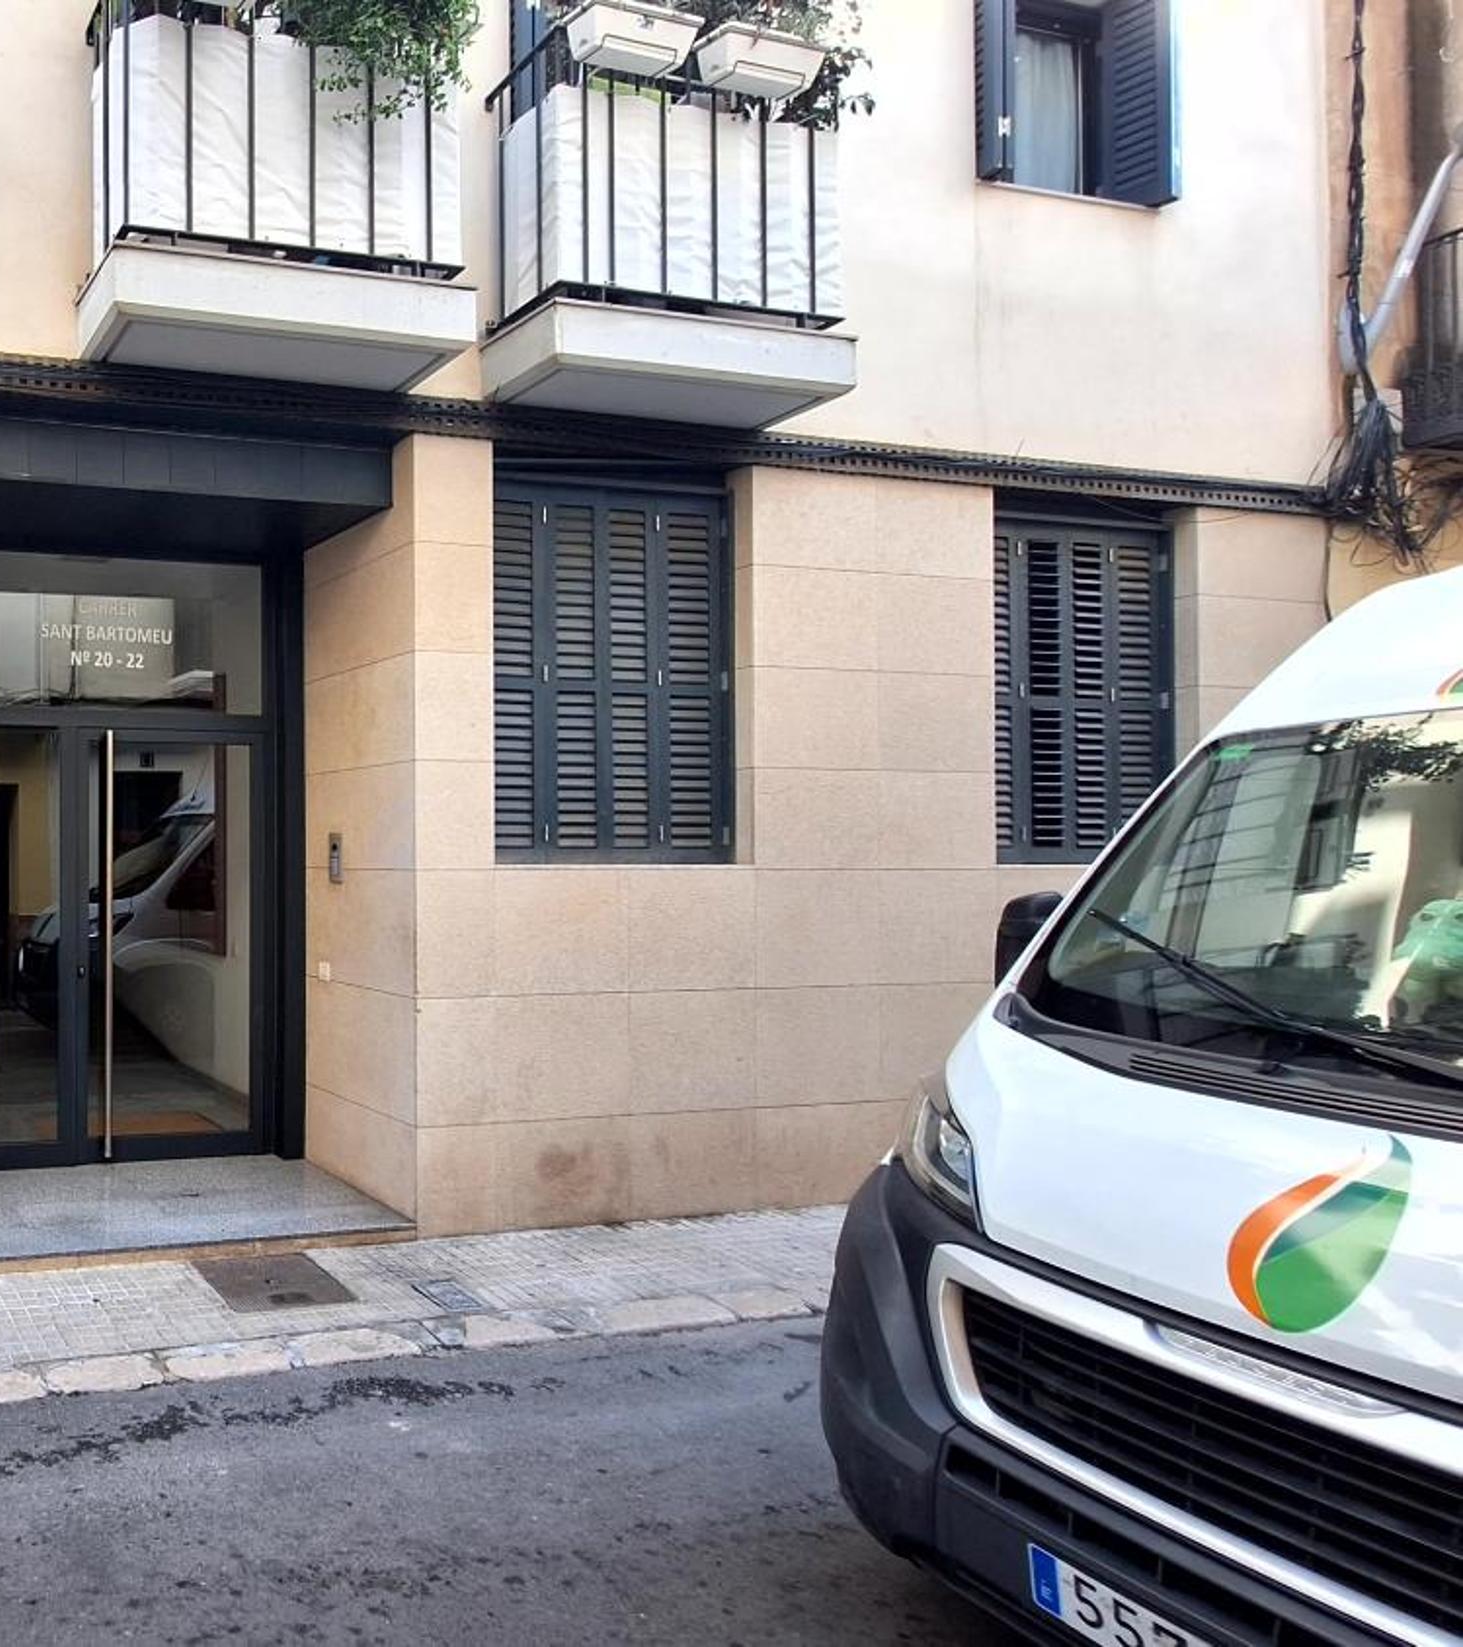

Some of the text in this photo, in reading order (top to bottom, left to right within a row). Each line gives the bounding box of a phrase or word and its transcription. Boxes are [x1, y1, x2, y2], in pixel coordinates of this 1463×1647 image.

[40, 623, 173, 645] SANT BARTOMEU
[94, 651, 114, 668] 20
[126, 653, 145, 669] 22
